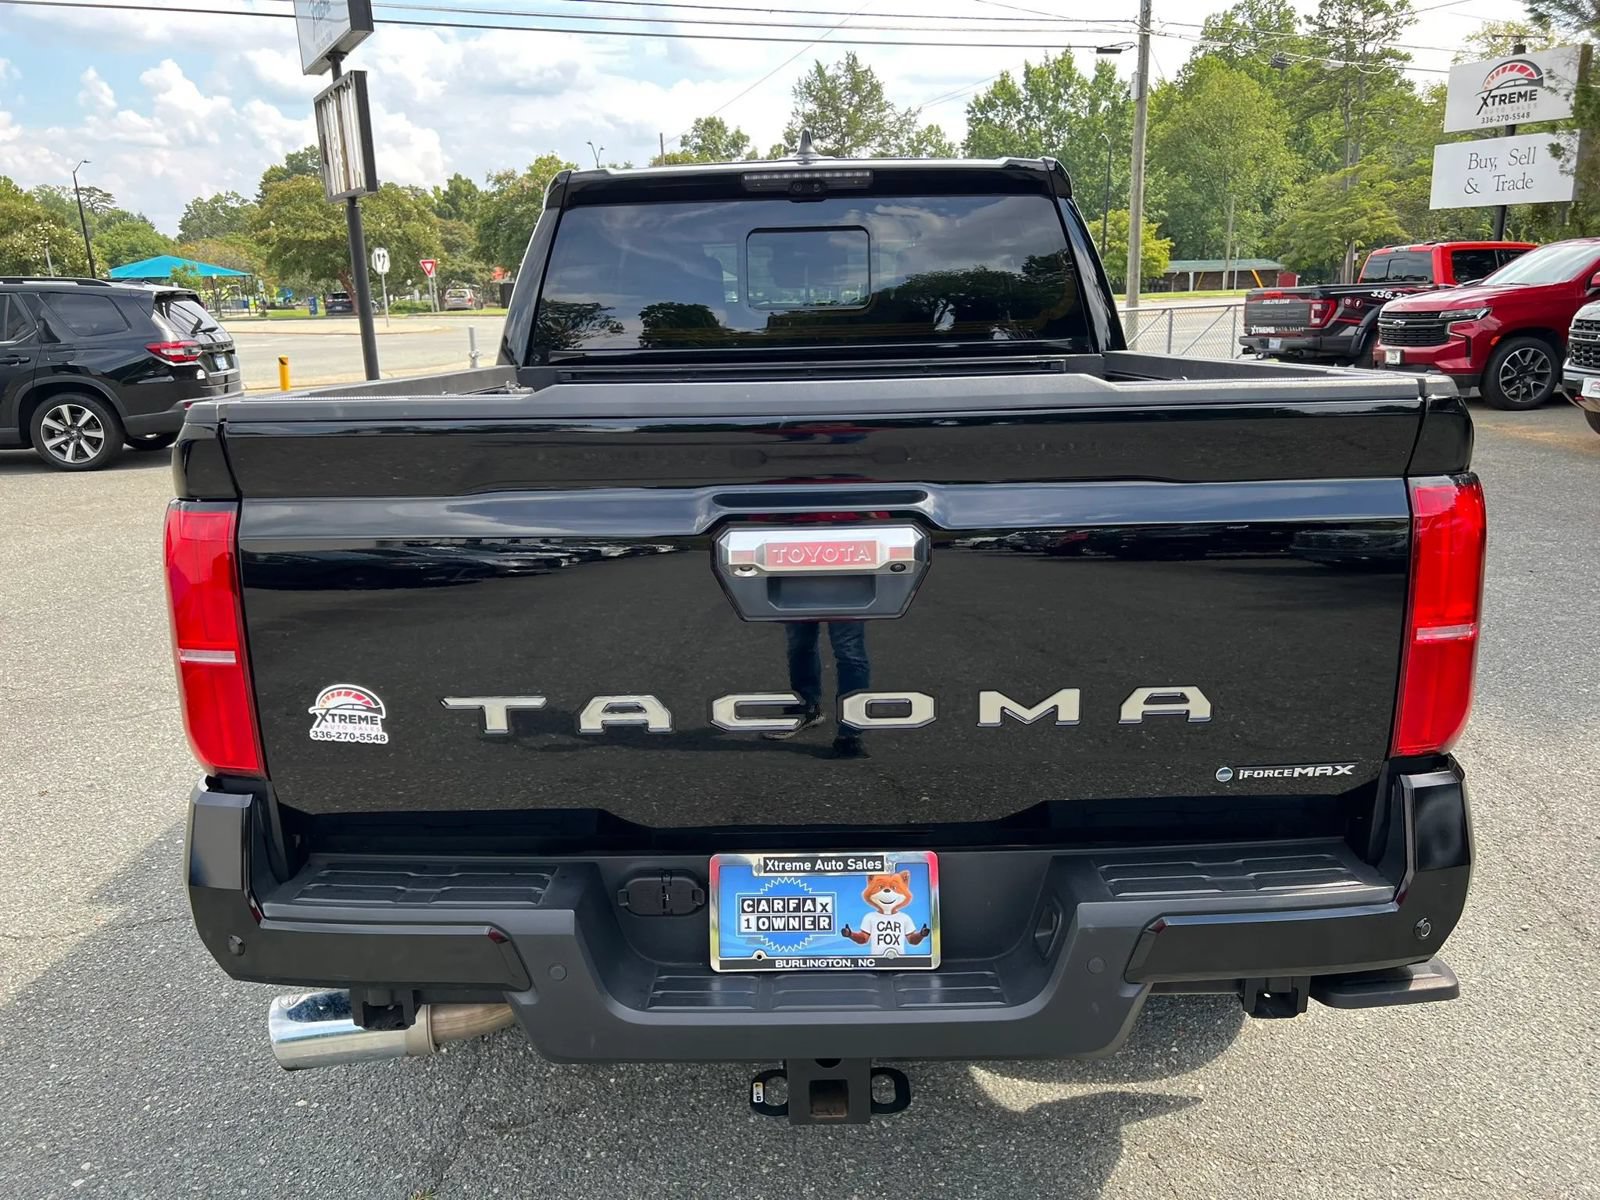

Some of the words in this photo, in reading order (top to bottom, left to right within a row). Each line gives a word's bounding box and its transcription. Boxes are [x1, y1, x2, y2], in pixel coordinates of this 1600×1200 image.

[1477, 89, 1538, 115] XTREME
[1484, 106, 1505, 115] AUTO
[1481, 112, 1531, 125] 336-270-5548
[1468, 152, 1498, 172] Buy,
[1508, 146, 1537, 166] Sell
[1464, 177, 1480, 194] &
[1493, 172, 1534, 192] Trade
[772, 545, 872, 564] TOYOTA
[440, 685, 1212, 734] TACOMA
[316, 709, 379, 728] XTREME
[312, 730, 386, 742] 336-270-5548
[766, 859, 811, 871] Xtreme
[815, 859, 844, 871] Auto
[847, 858, 882, 870] Sales
[744, 917, 753, 930] 1
[758, 916, 830, 930] OWNER
[877, 920, 902, 932] CAR
[877, 933, 901, 946] FOX
[775, 959, 855, 969] BURLINGTON,
[858, 959, 876, 967] NC
